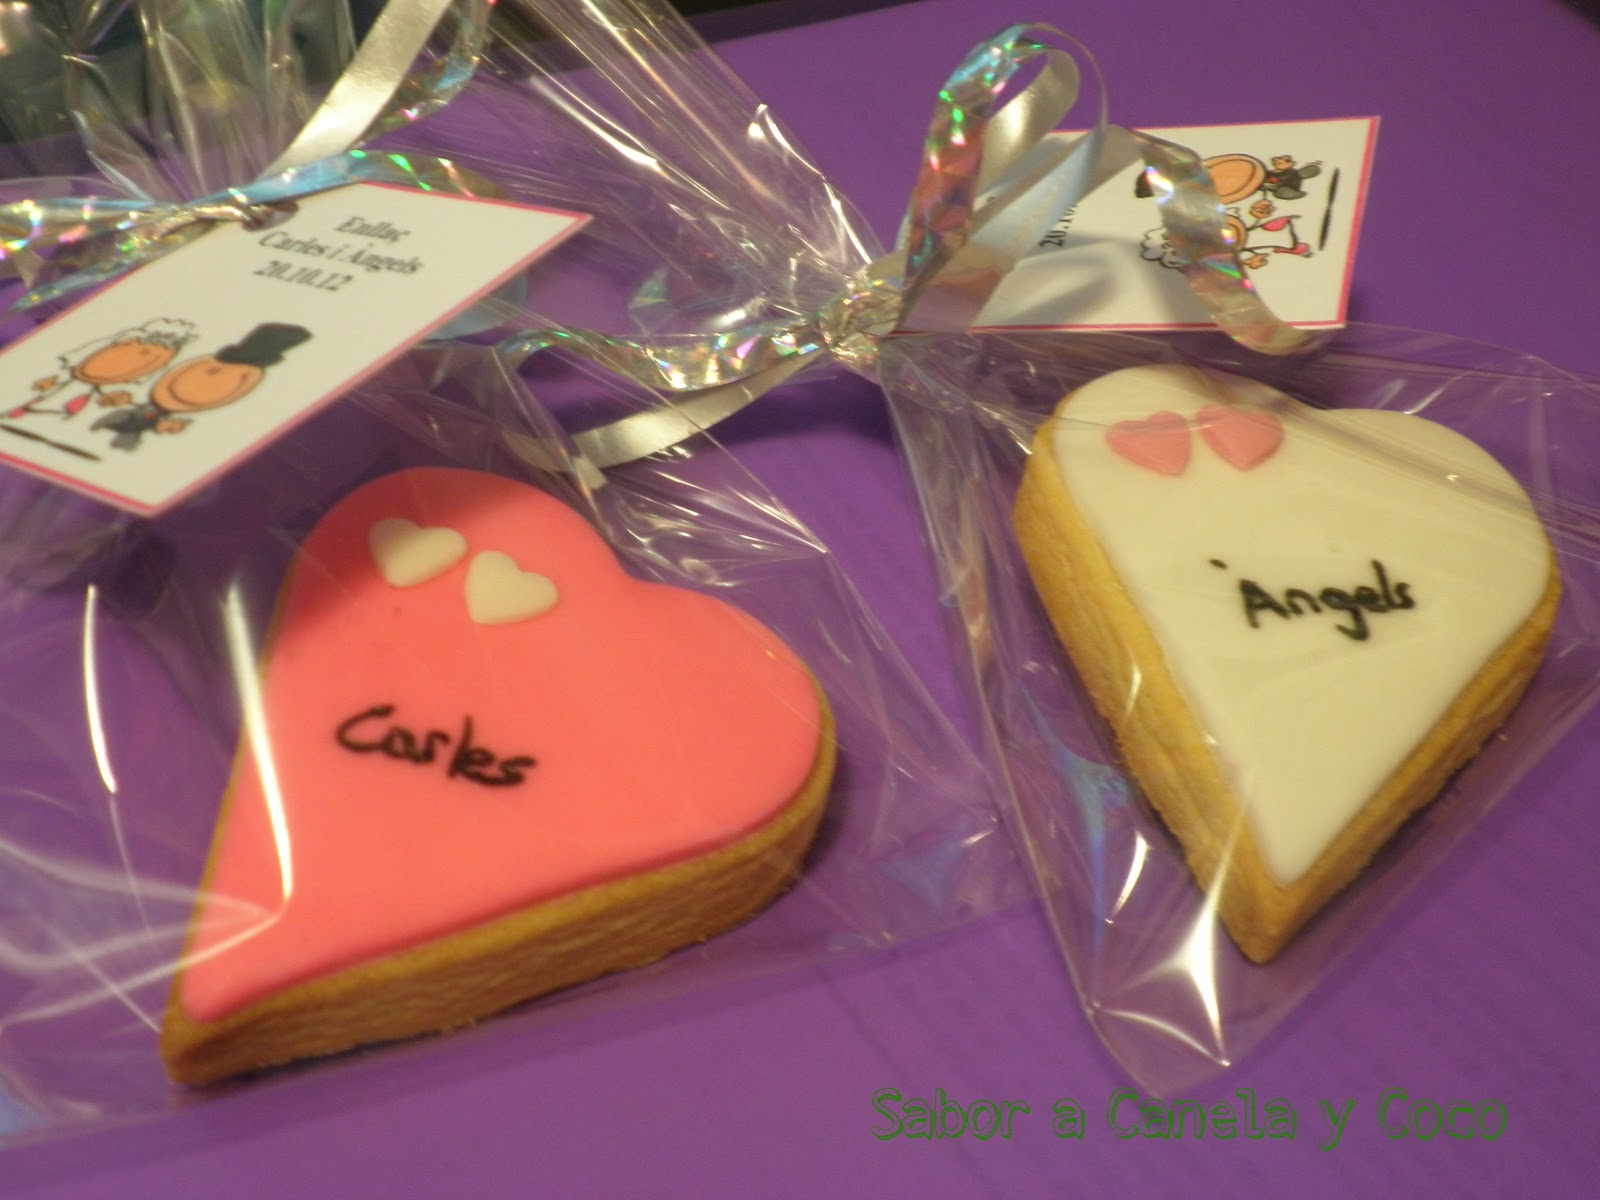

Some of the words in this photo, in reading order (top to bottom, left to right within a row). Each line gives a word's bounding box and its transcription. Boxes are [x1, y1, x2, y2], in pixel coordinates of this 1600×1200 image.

[258, 231, 330, 257] Carles
[327, 244, 350, 260] i
[253, 260, 354, 291] 20.10.12
[335, 704, 537, 787] Carles
